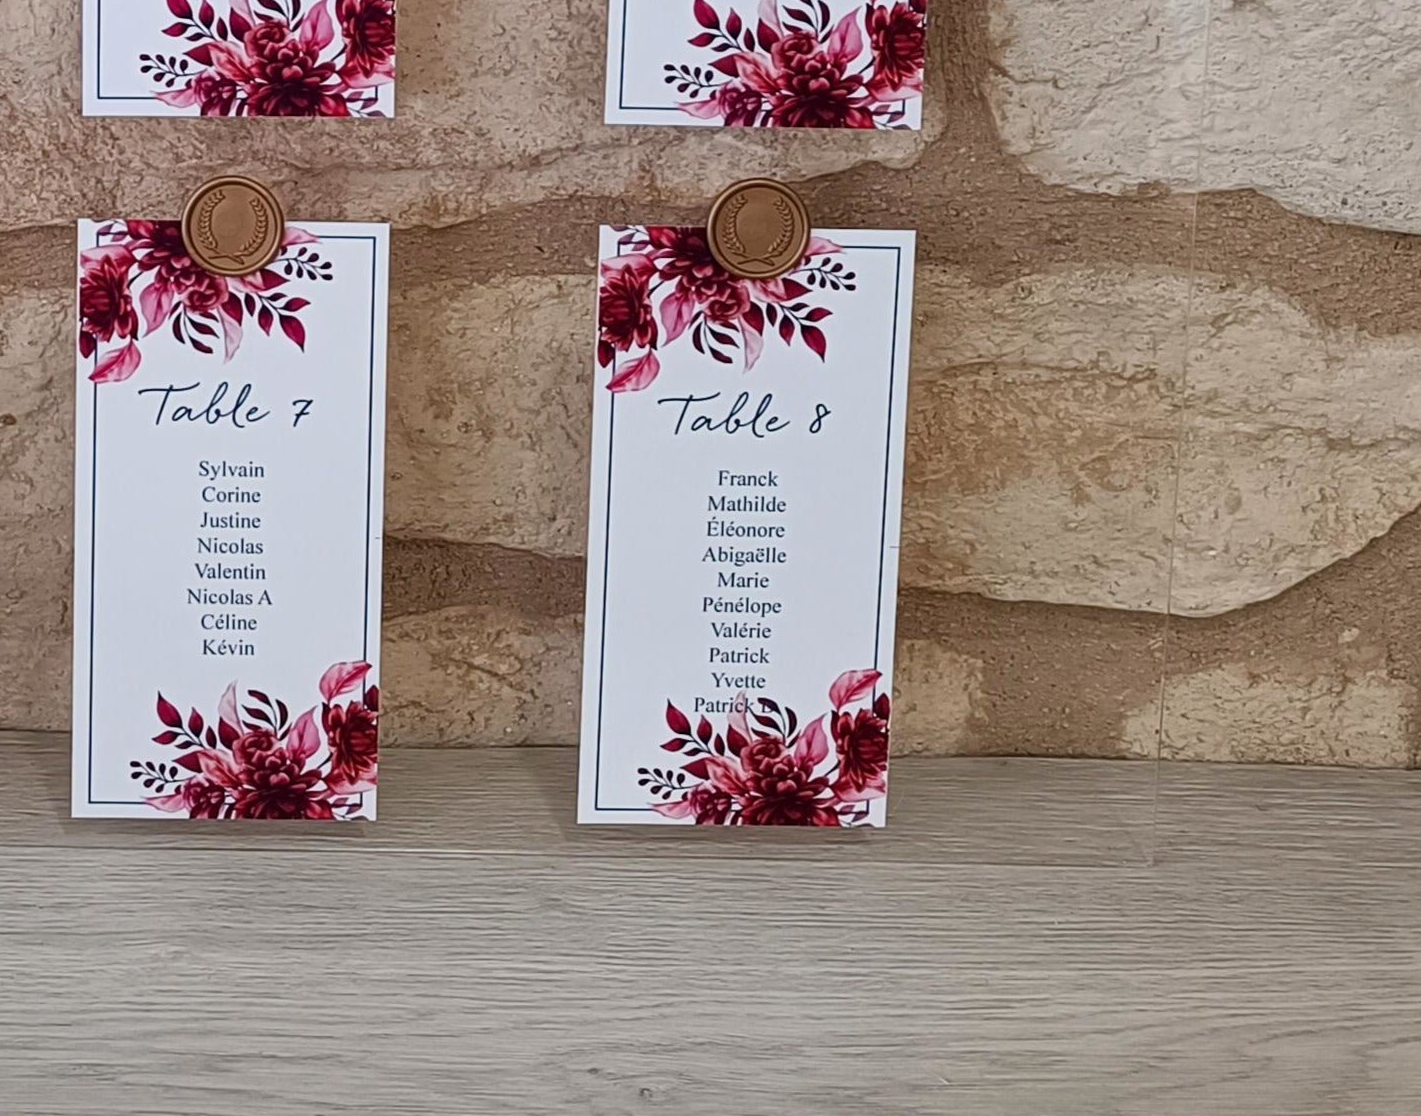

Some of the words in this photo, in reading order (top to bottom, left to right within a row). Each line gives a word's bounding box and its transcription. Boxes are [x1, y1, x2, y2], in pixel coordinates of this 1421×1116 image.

[138, 381, 270, 428] Table
[292, 399, 314, 427] 7
[657, 391, 790, 438] Table
[809, 404, 831, 434] 8
[199, 460, 264, 481] Sylvain
[718, 470, 778, 487] Franck
[202, 486, 261, 503] Corine
[708, 496, 786, 512] Mathilde
[200, 512, 261, 528] Justine
[707, 516, 785, 538] Éléonore
[197, 537, 263, 554] Nicolas
[702, 546, 786, 567] Abigaëlle
[195, 563, 266, 580] Valentin
[718, 572, 769, 588] Marie
[187, 588, 253, 605] Nicolas
[258, 590, 272, 605] A
[703, 597, 782, 618] Pénélope
[201, 614, 257, 630] Céline
[711, 622, 771, 638] Valérie
[203, 639, 254, 655] Kévin
[709, 647, 769, 663] Patrick
[711, 672, 766, 689] Yvette
[694, 697, 753, 713] Patrick
